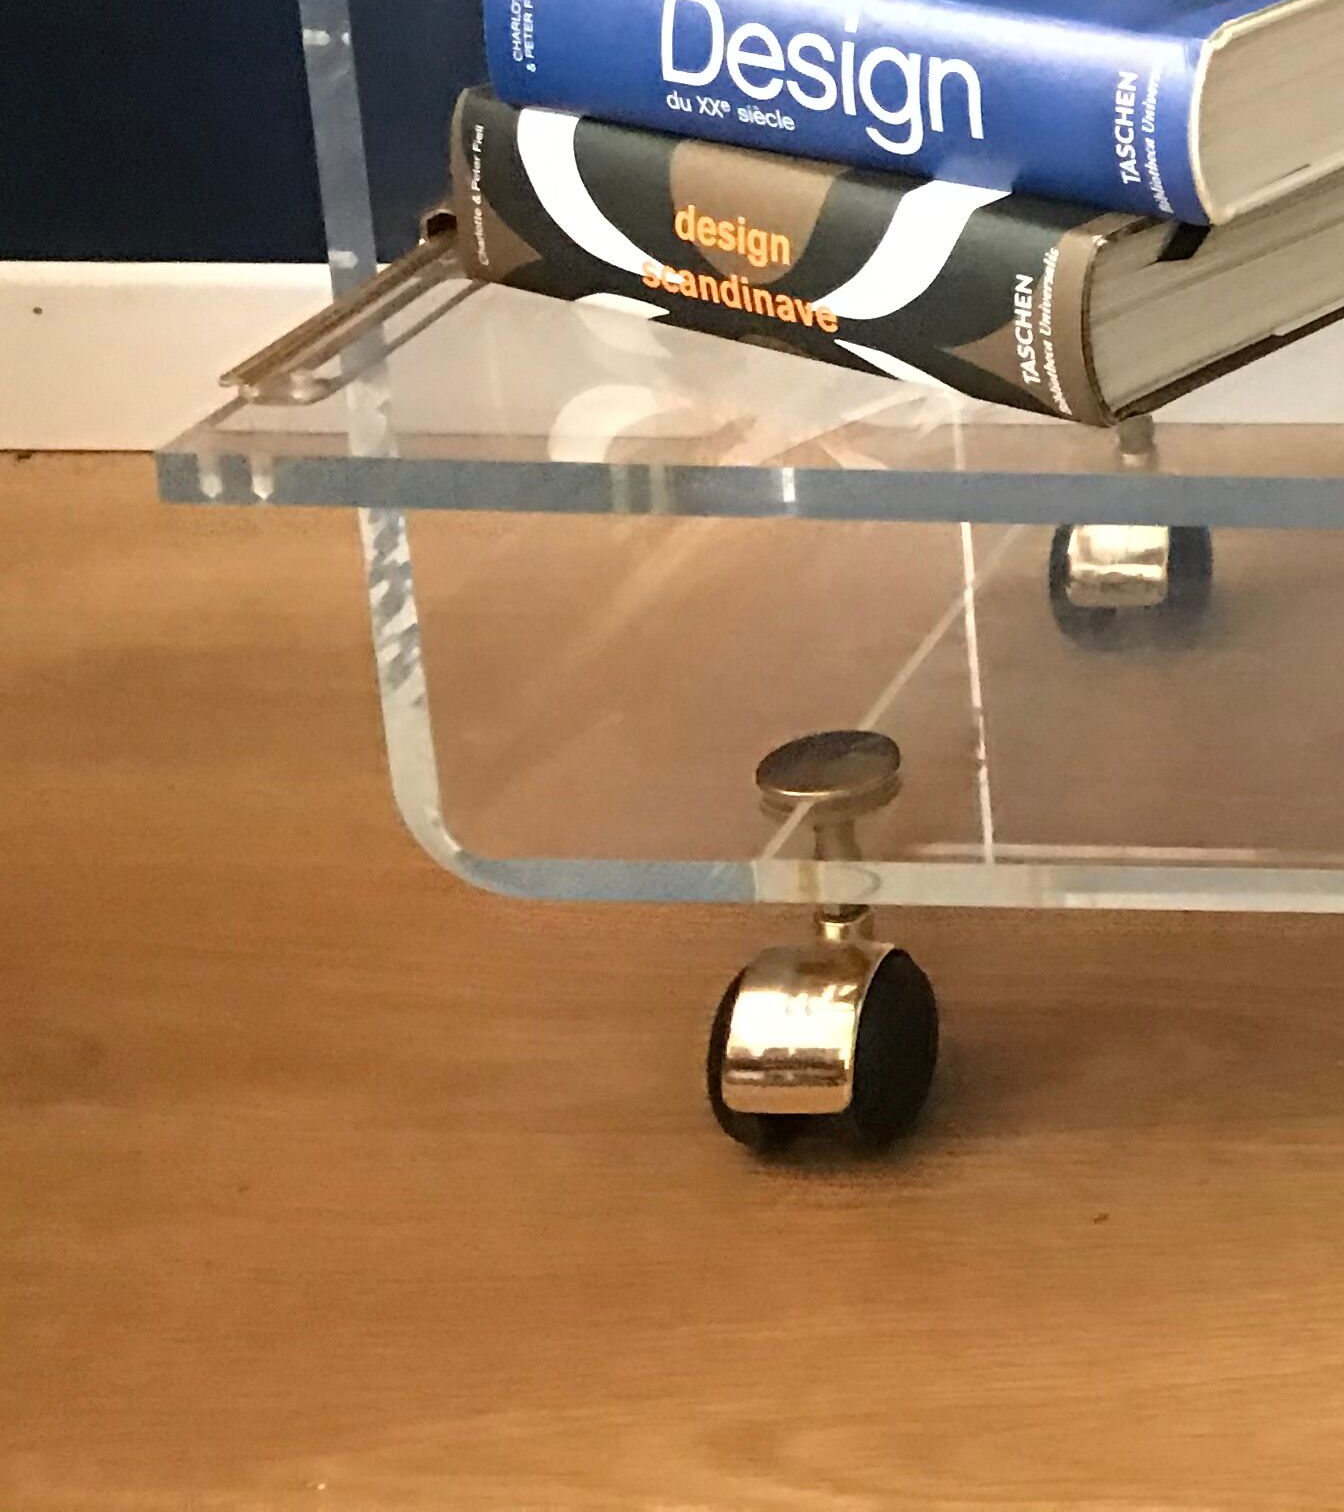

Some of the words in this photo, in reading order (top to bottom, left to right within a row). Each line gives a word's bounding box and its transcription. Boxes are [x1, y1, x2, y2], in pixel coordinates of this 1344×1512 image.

[523, 12, 535, 59] PETER
[472, 124, 485, 153] Fiell
[666, 90, 692, 113] du
[737, 104, 796, 131] siècle
[1114, 71, 1141, 185] TASCHEN
[471, 155, 482, 192] Peter
[674, 204, 791, 268] design
[642, 260, 839, 334] scandinave
[1039, 246, 1060, 337] Universalis
[1014, 273, 1042, 385] TASCHEN
